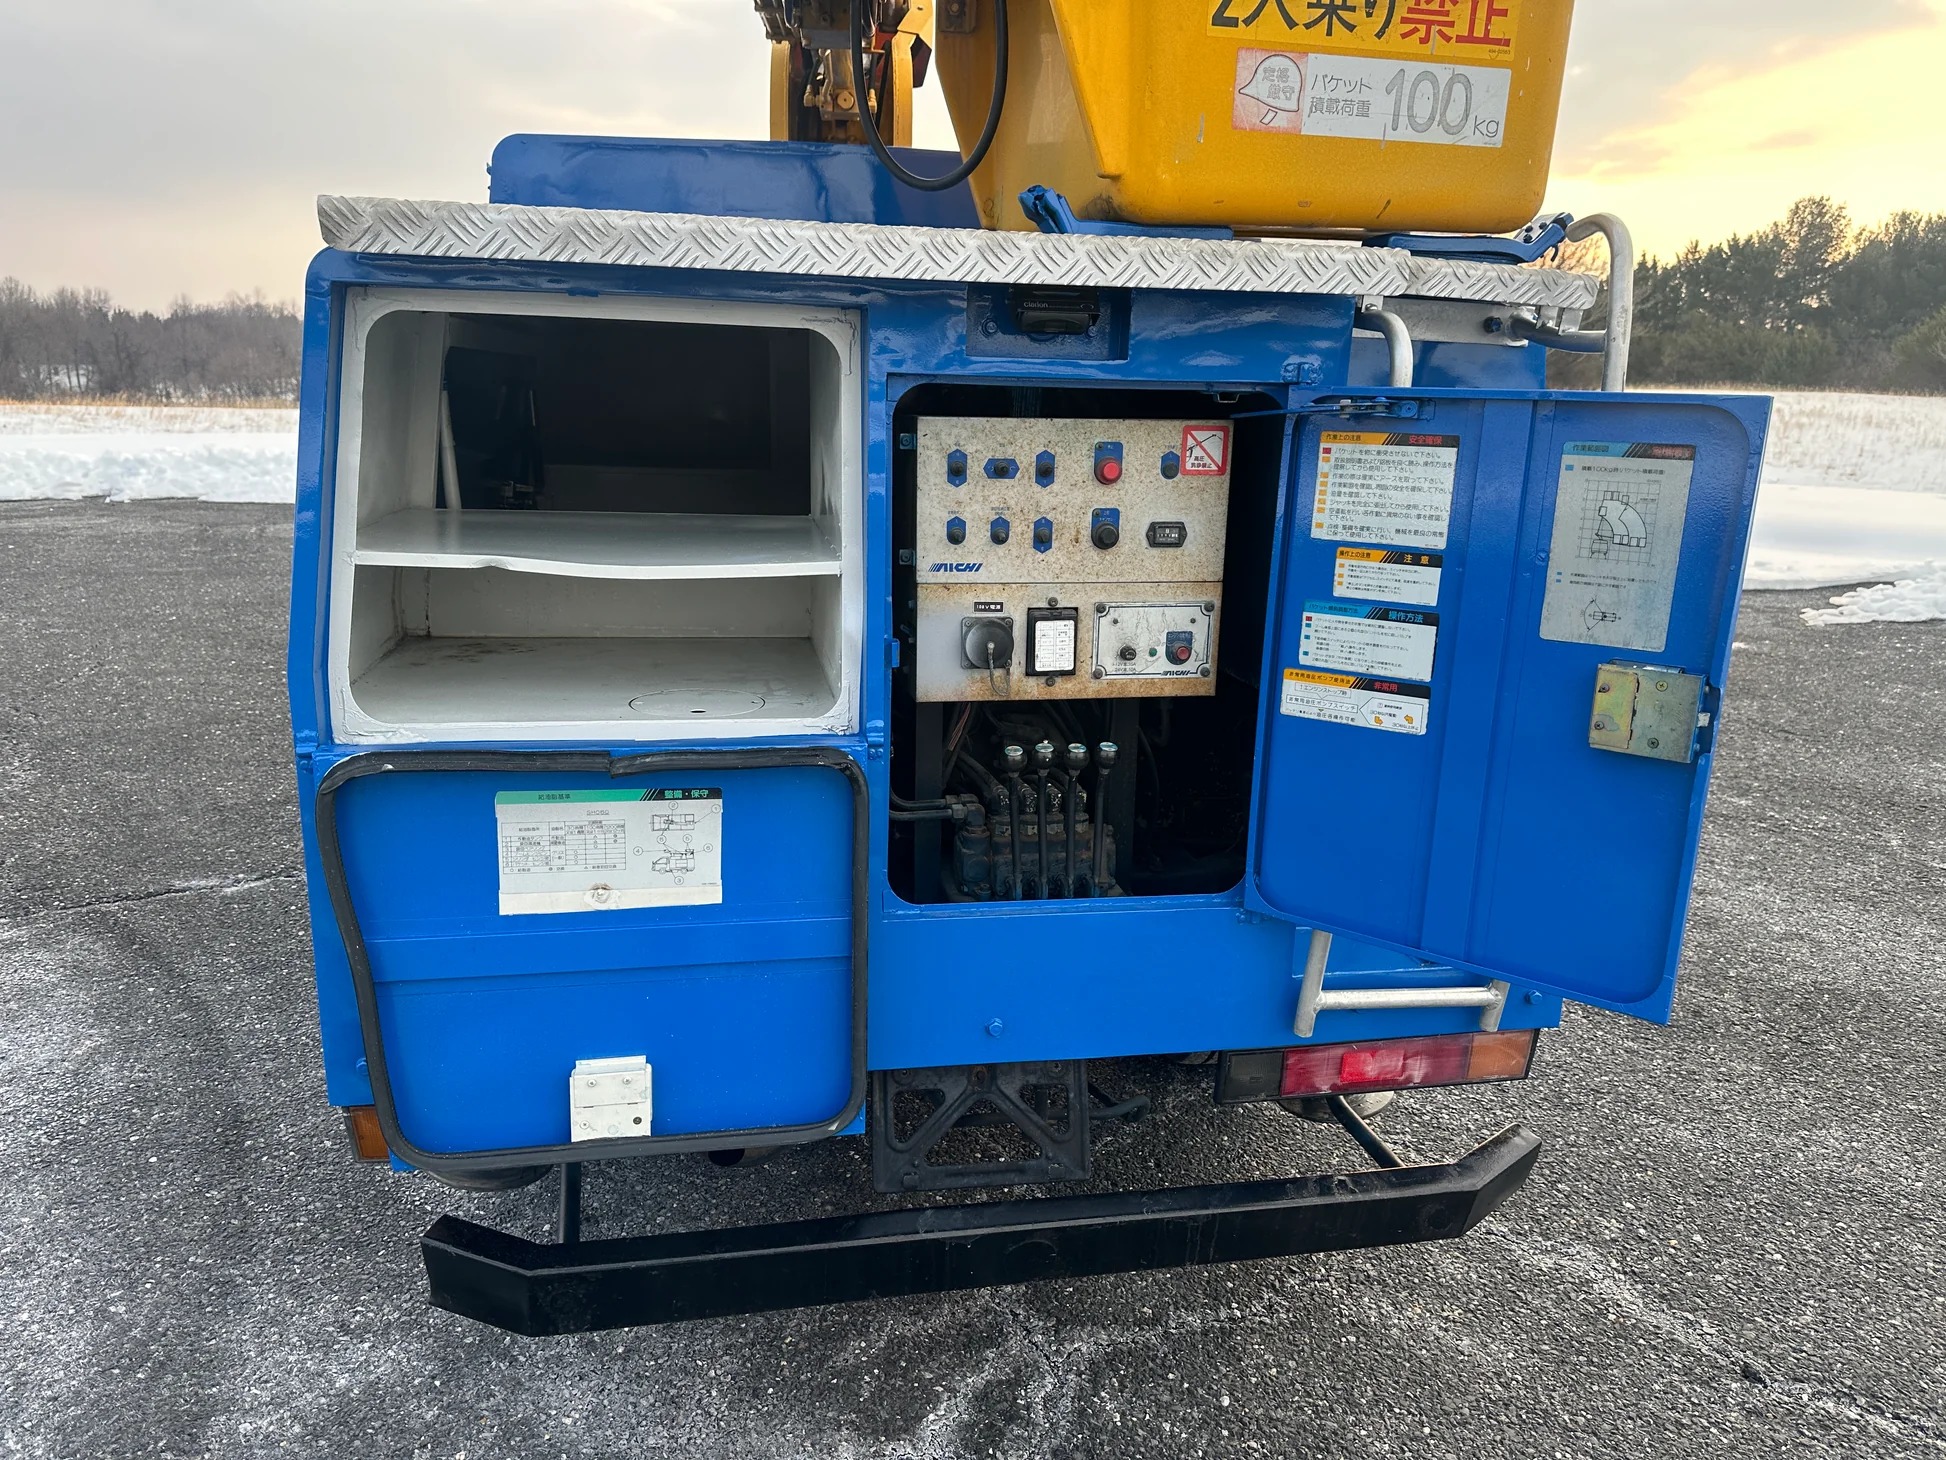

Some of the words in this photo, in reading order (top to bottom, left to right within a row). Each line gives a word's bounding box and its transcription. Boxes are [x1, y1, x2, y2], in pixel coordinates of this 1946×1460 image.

[1309, 97, 1371, 118] 積載荷重
[1385, 68, 1472, 135] 100
[1473, 115, 1499, 138] kg
[1409, 435, 1442, 445] 安全確保
[1388, 610, 1424, 623] 操作方法
[1373, 681, 1398, 692] 非常用
